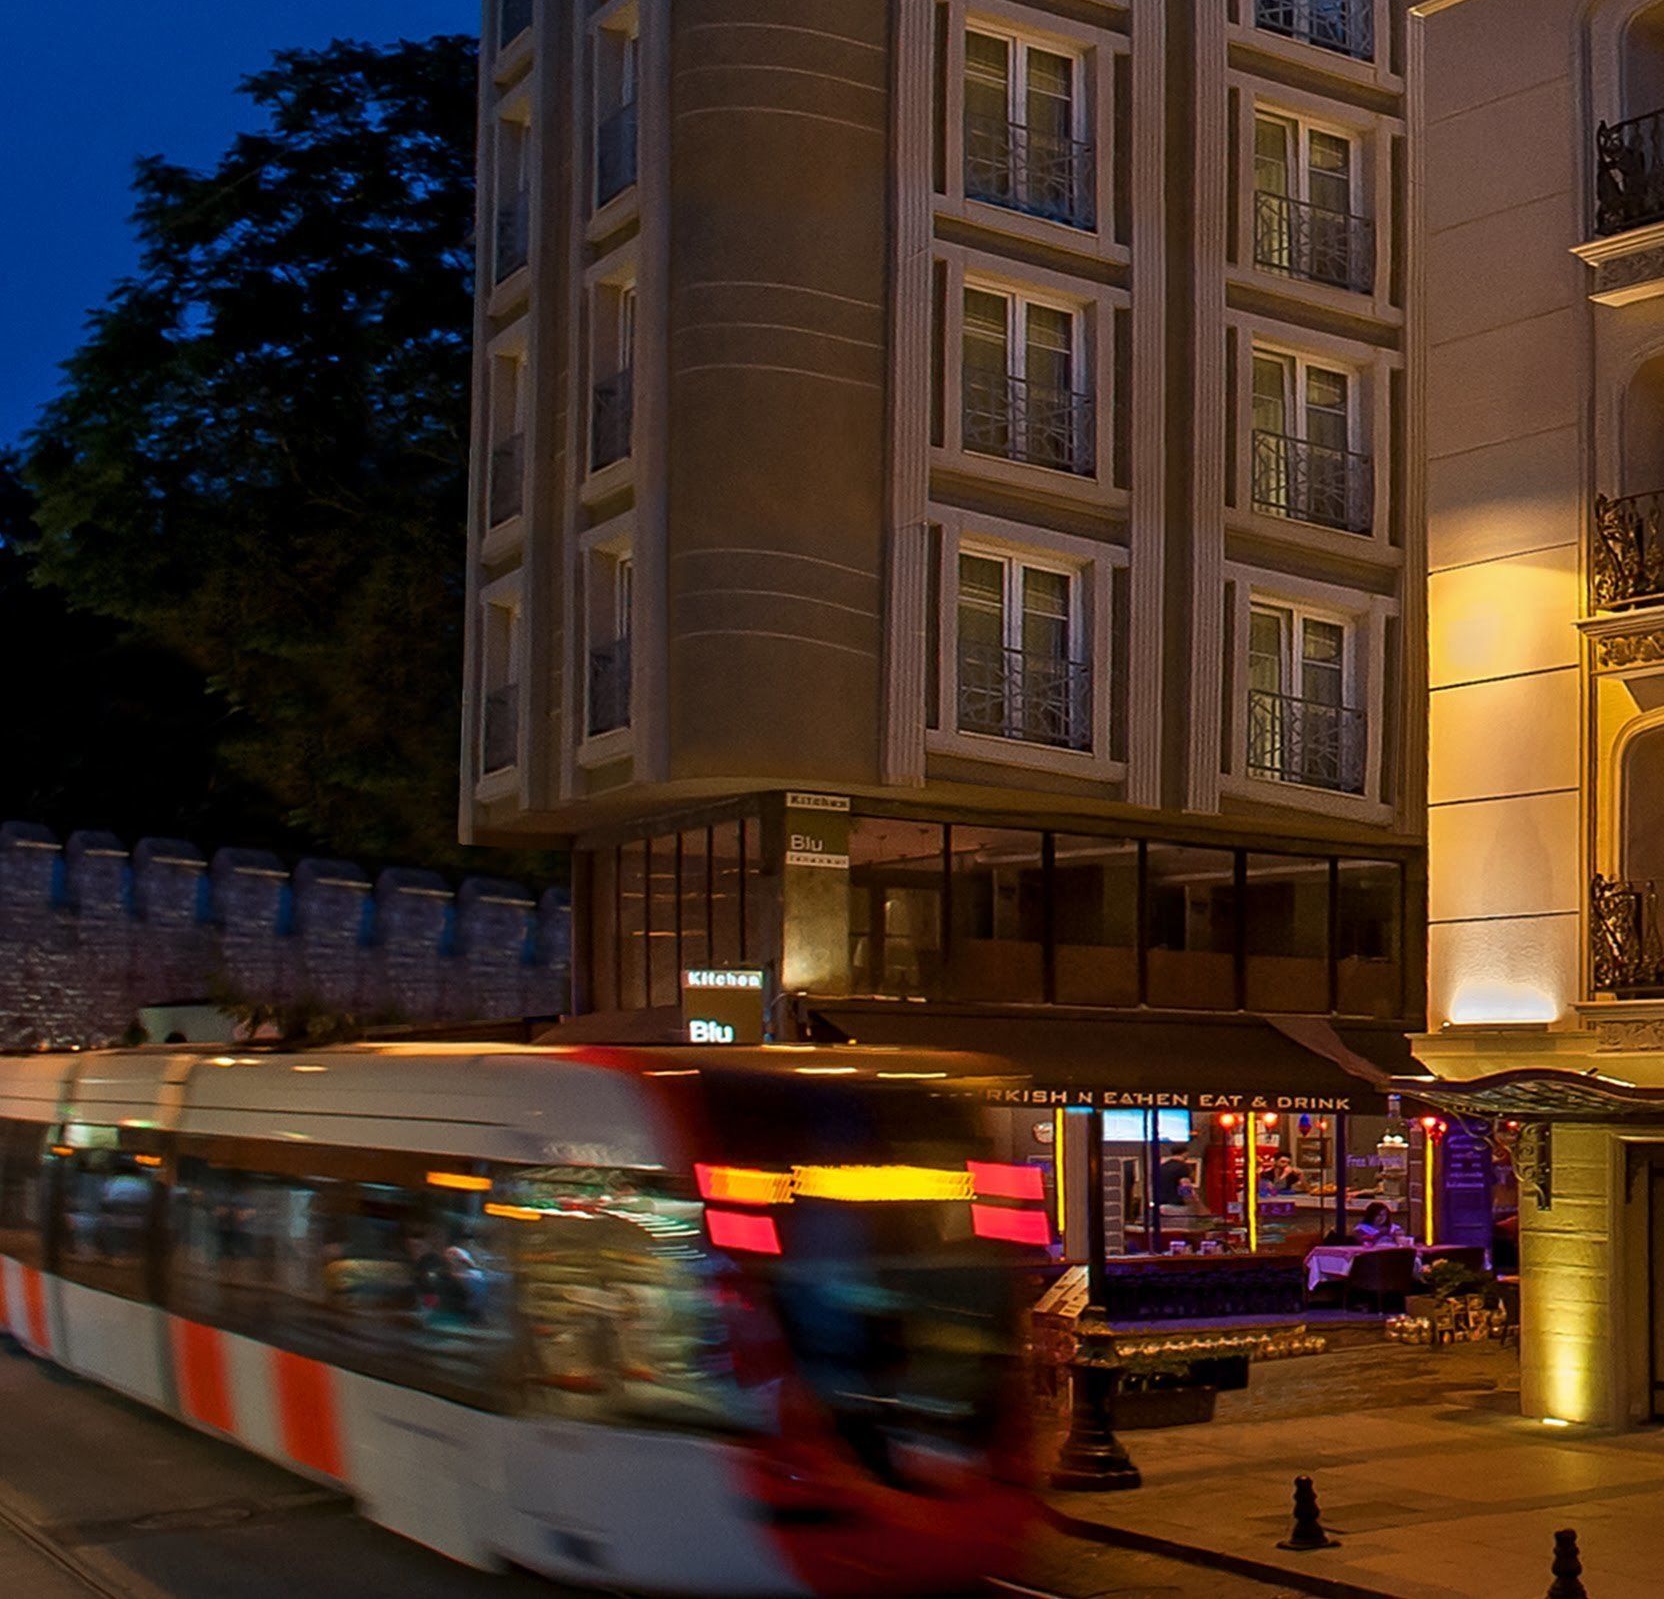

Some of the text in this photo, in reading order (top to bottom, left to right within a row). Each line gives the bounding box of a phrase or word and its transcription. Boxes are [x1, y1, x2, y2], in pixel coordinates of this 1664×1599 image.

[791, 834, 823, 851] Blu
[688, 971, 761, 986] Kitchen
[689, 1020, 734, 1043] Blu
[985, 1089, 1067, 1103] RKISH
[1200, 1094, 1243, 1107] EAT
[1251, 1096, 1267, 1108] &
[1277, 1097, 1350, 1110] DRINK
